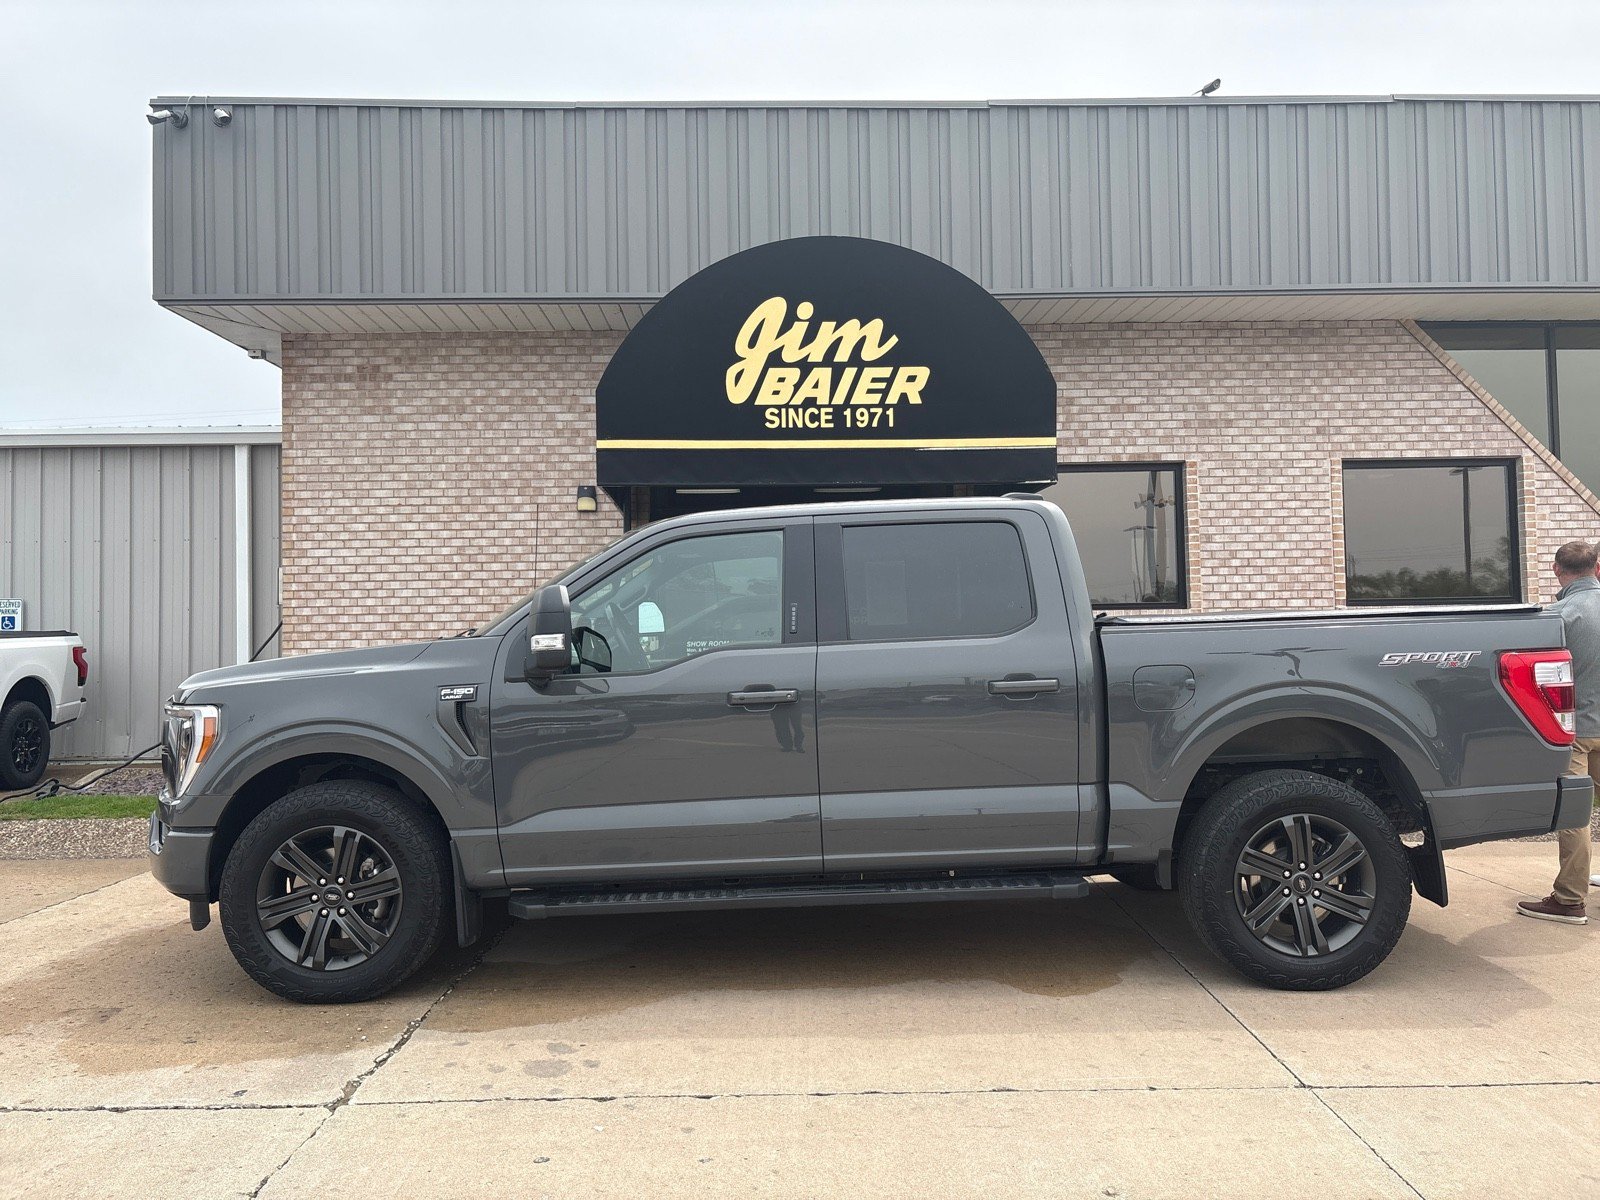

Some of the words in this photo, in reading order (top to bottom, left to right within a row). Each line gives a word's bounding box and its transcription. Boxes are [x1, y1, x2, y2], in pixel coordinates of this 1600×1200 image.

[725, 296, 899, 405] Jim
[754, 366, 931, 406] BAIER
[764, 407, 835, 428] SINCE
[843, 407, 895, 428] 1971
[1378, 650, 1482, 666] SPORT
